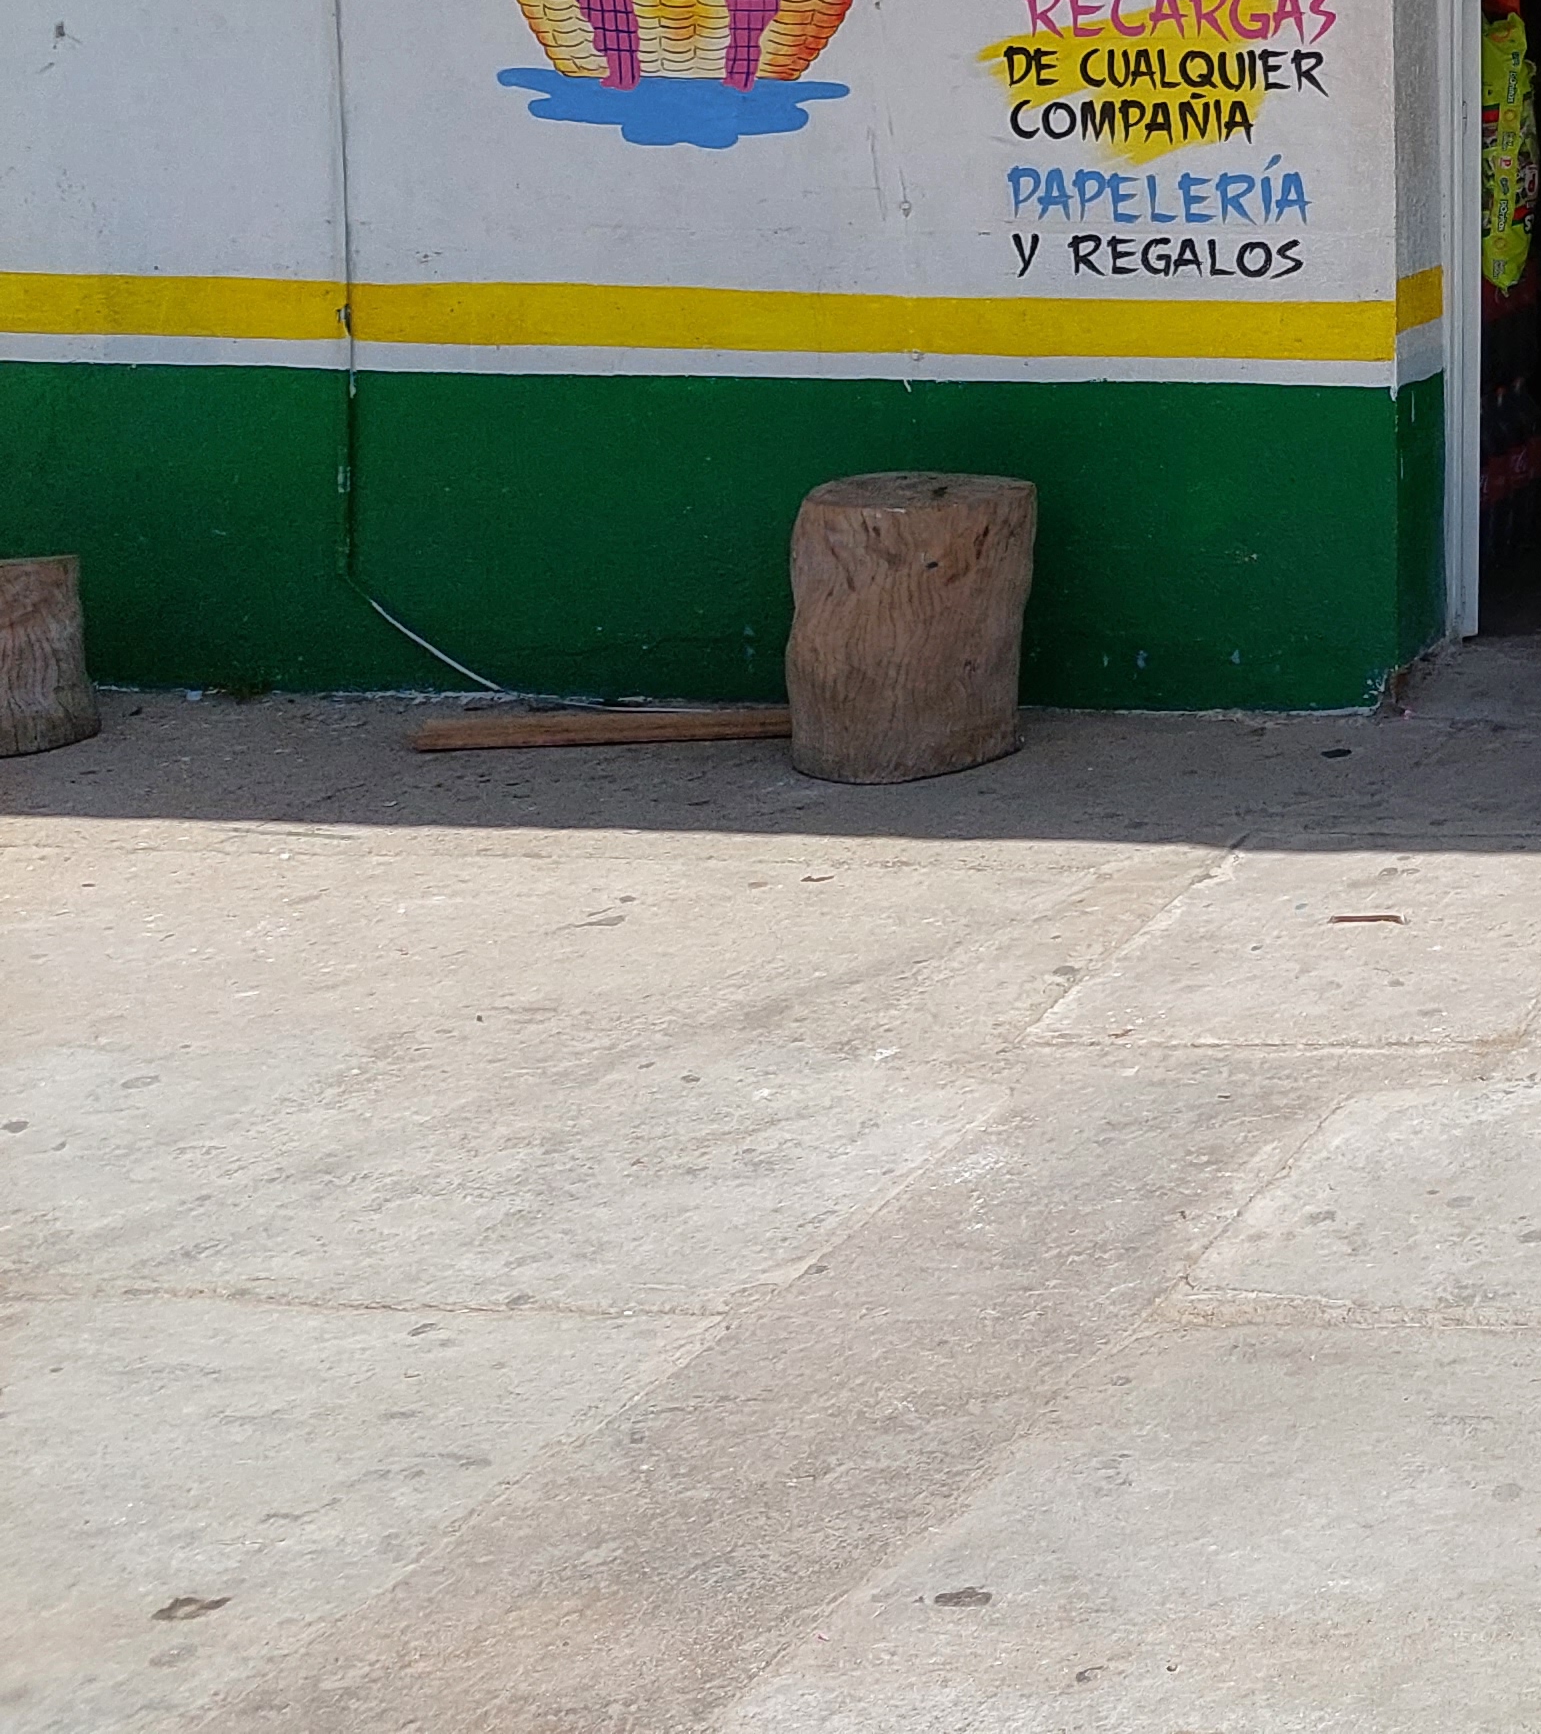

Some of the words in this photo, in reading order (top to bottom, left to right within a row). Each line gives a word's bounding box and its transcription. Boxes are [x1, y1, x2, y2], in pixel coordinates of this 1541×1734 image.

[1004, 46, 1058, 88] DE
[1080, 47, 1329, 98] CUALQUIER
[1009, 92, 1254, 144] COMPAÑIA
[1007, 153, 1313, 225] PAPELERÍA
[1012, 232, 1040, 278] Y
[1067, 233, 1304, 280] REGALOS
